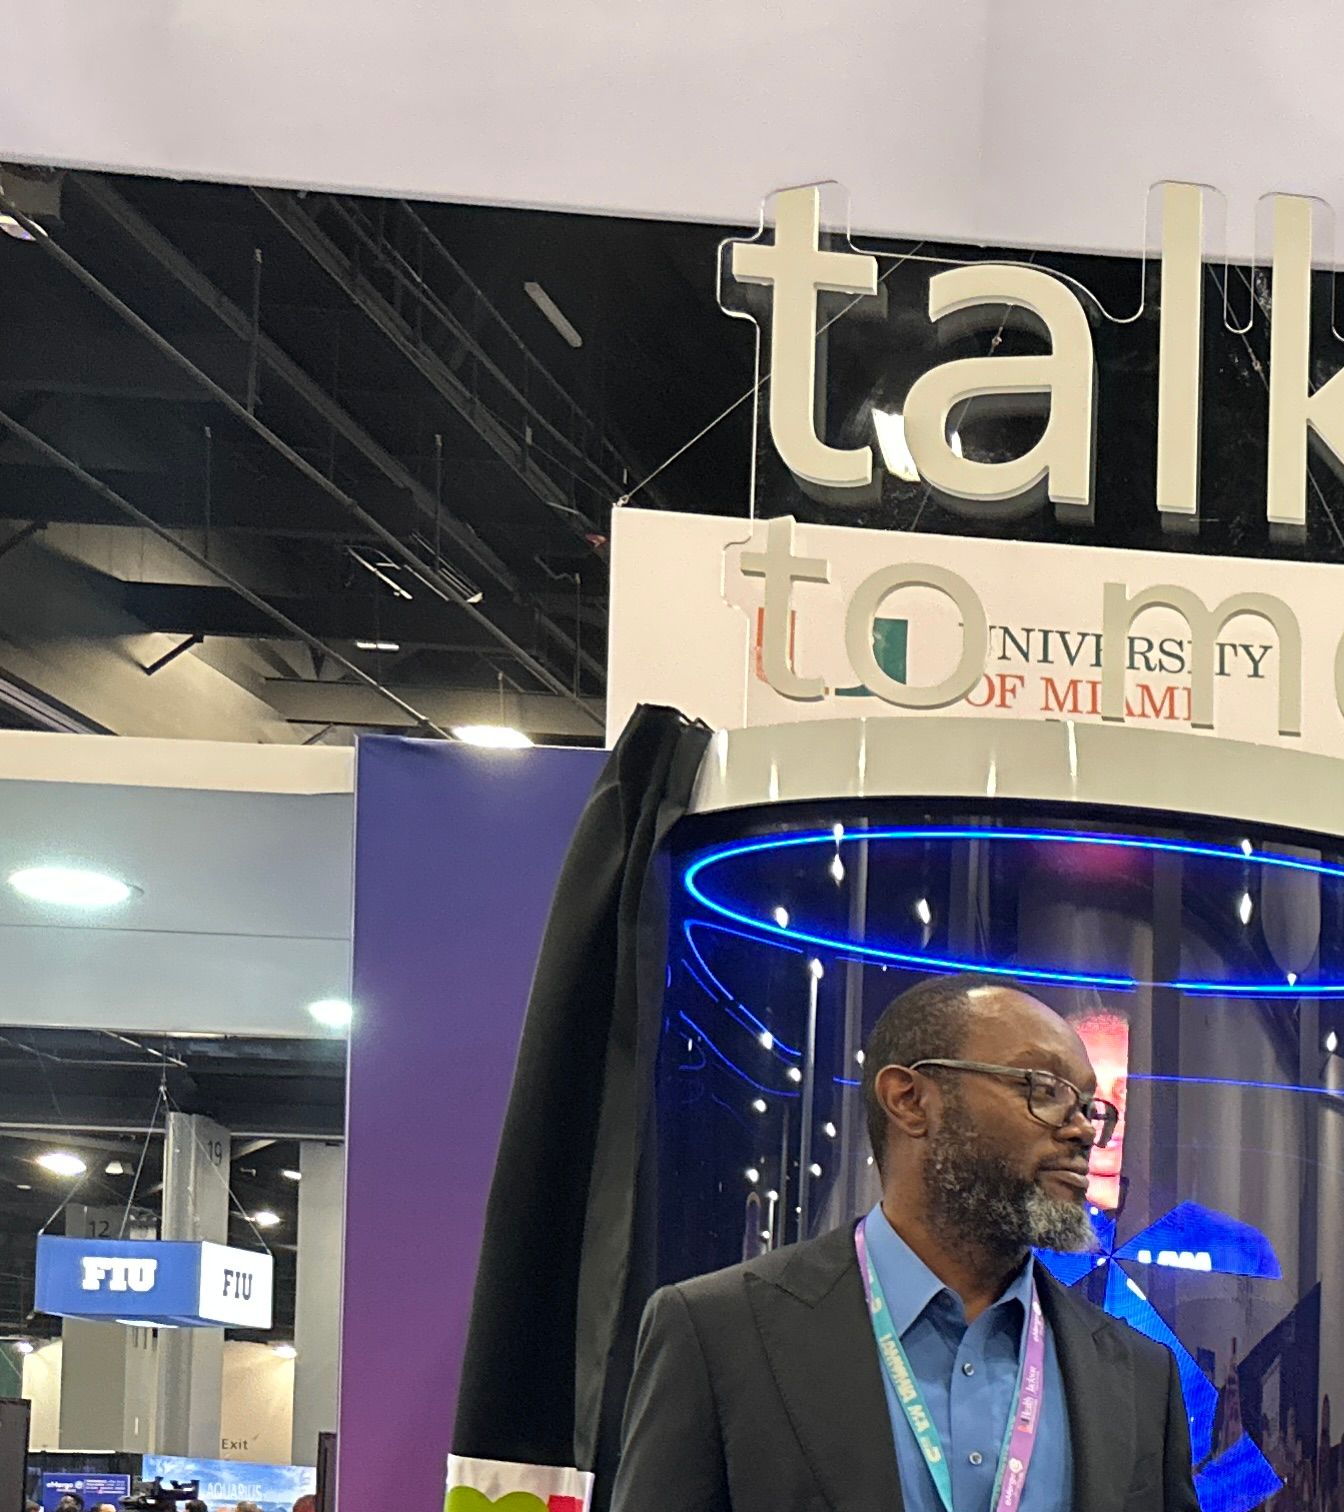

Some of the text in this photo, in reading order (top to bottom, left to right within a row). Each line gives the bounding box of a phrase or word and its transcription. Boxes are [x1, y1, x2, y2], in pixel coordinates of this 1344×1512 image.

[740, 515, 989, 710] to
[958, 621, 1273, 679] NIVRSTY
[1039, 675, 1192, 721] MIMI
[82, 1256, 158, 1292] FIU
[223, 1268, 253, 1301] FIU
[221, 1438, 249, 1450] Exit
